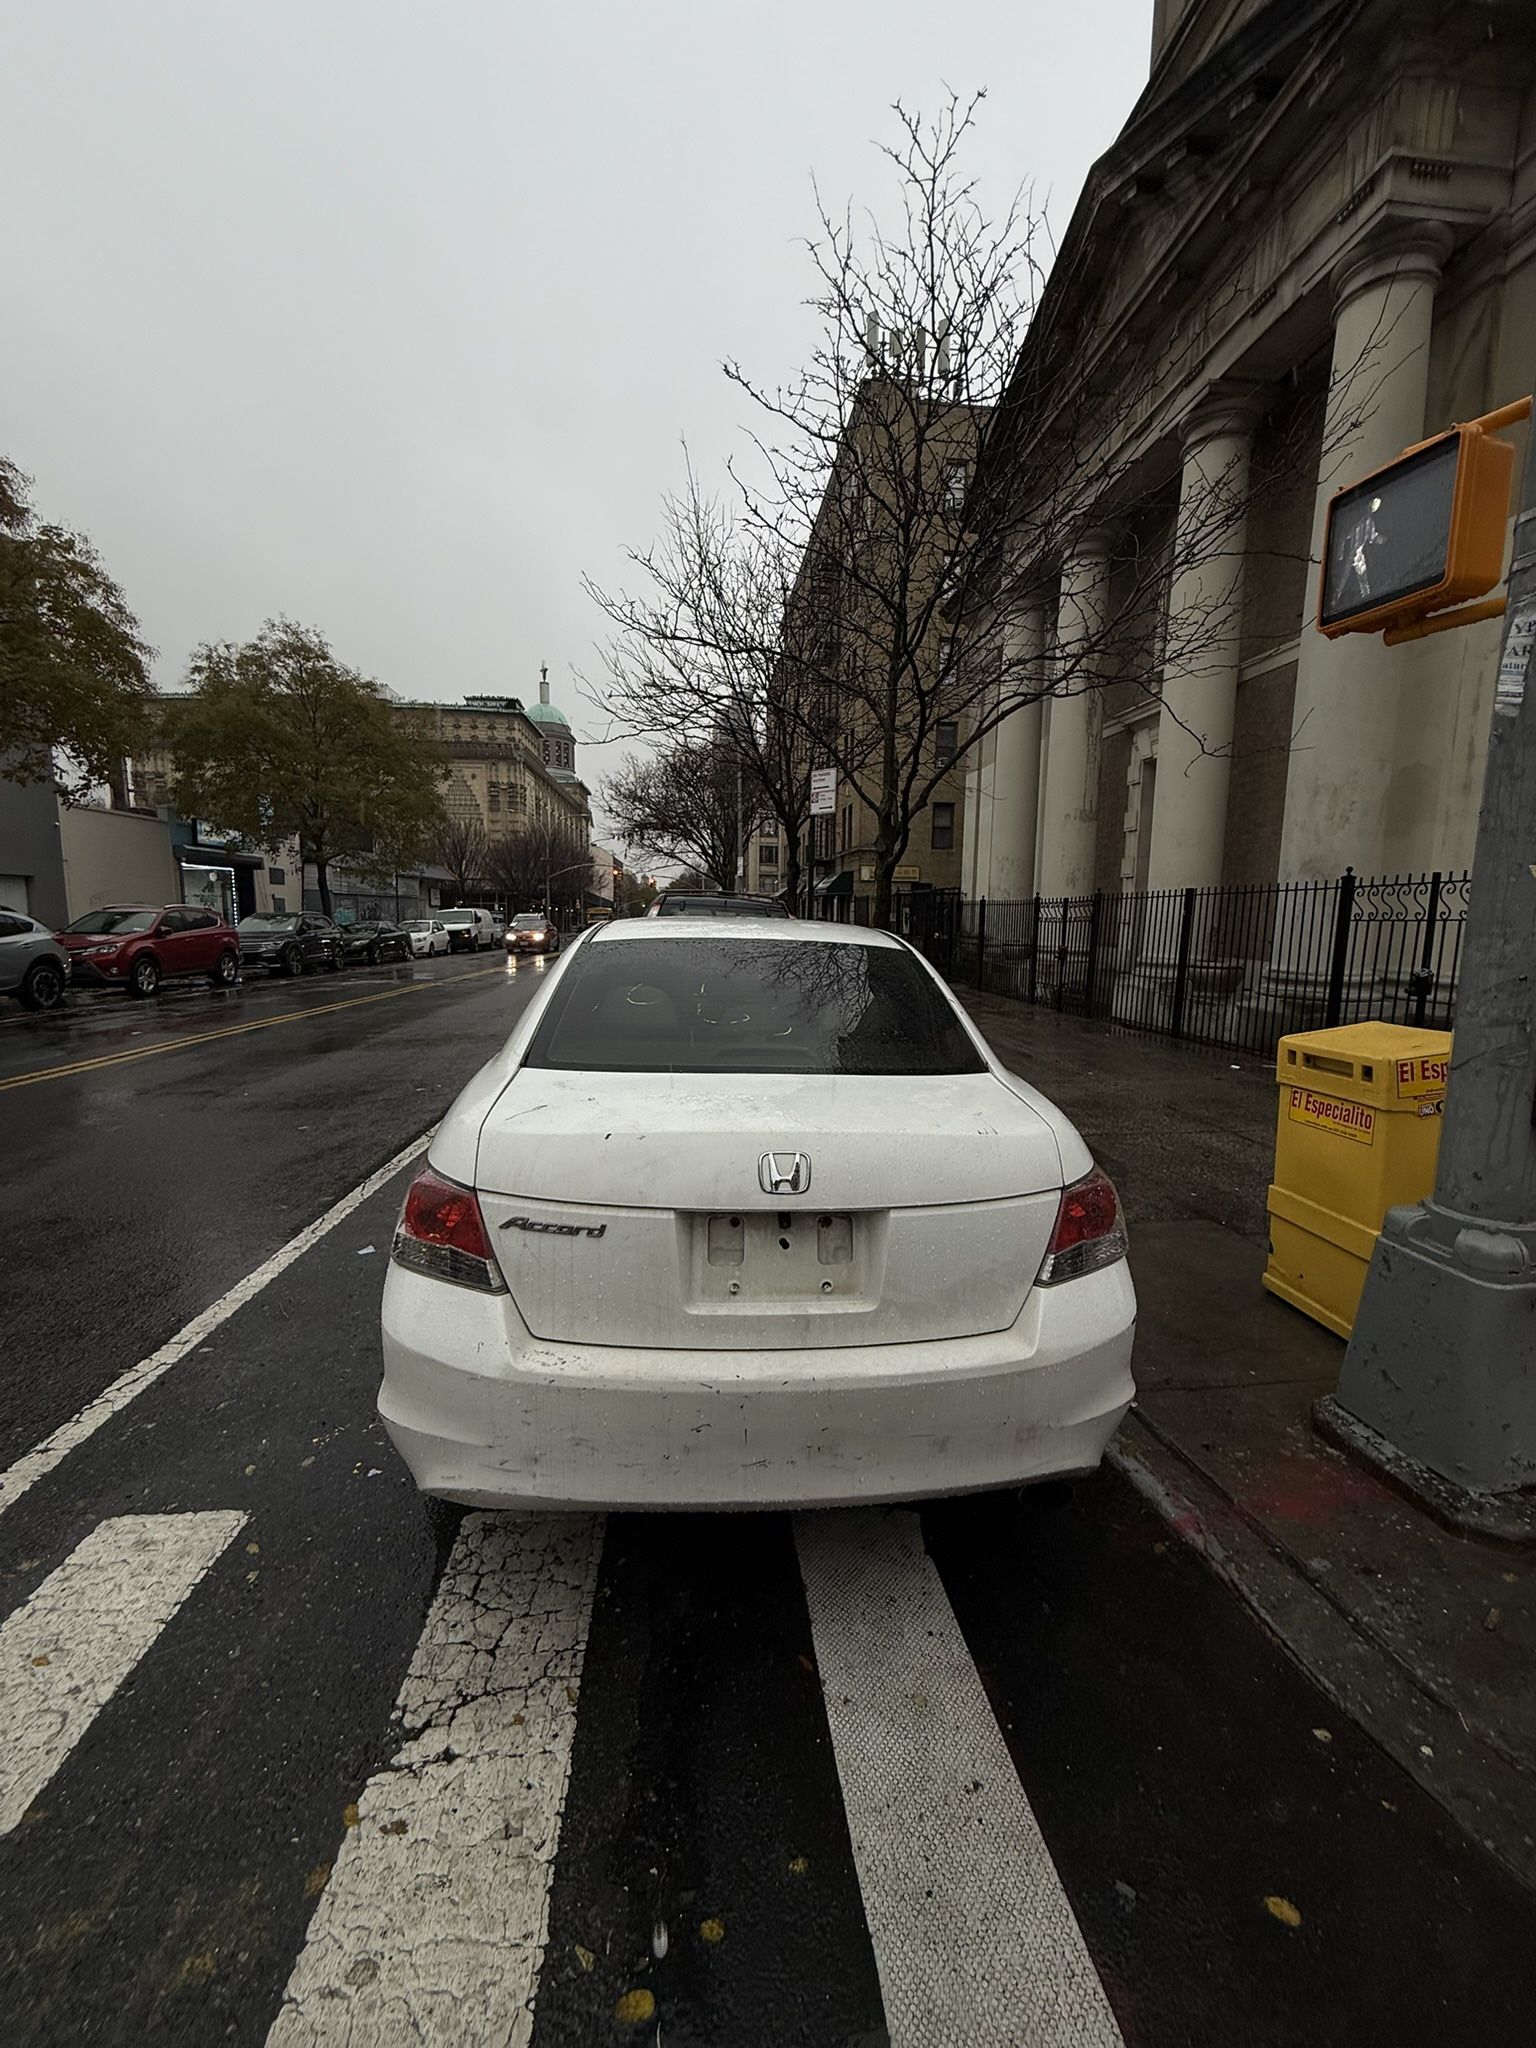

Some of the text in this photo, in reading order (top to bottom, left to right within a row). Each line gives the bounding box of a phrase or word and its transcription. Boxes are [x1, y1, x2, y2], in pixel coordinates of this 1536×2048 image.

[1399, 1061, 1415, 1083] El
[1291, 1089, 1302, 1109] El
[1304, 1092, 1372, 1130] Especialito
[498, 1215, 608, 1239] Accord
